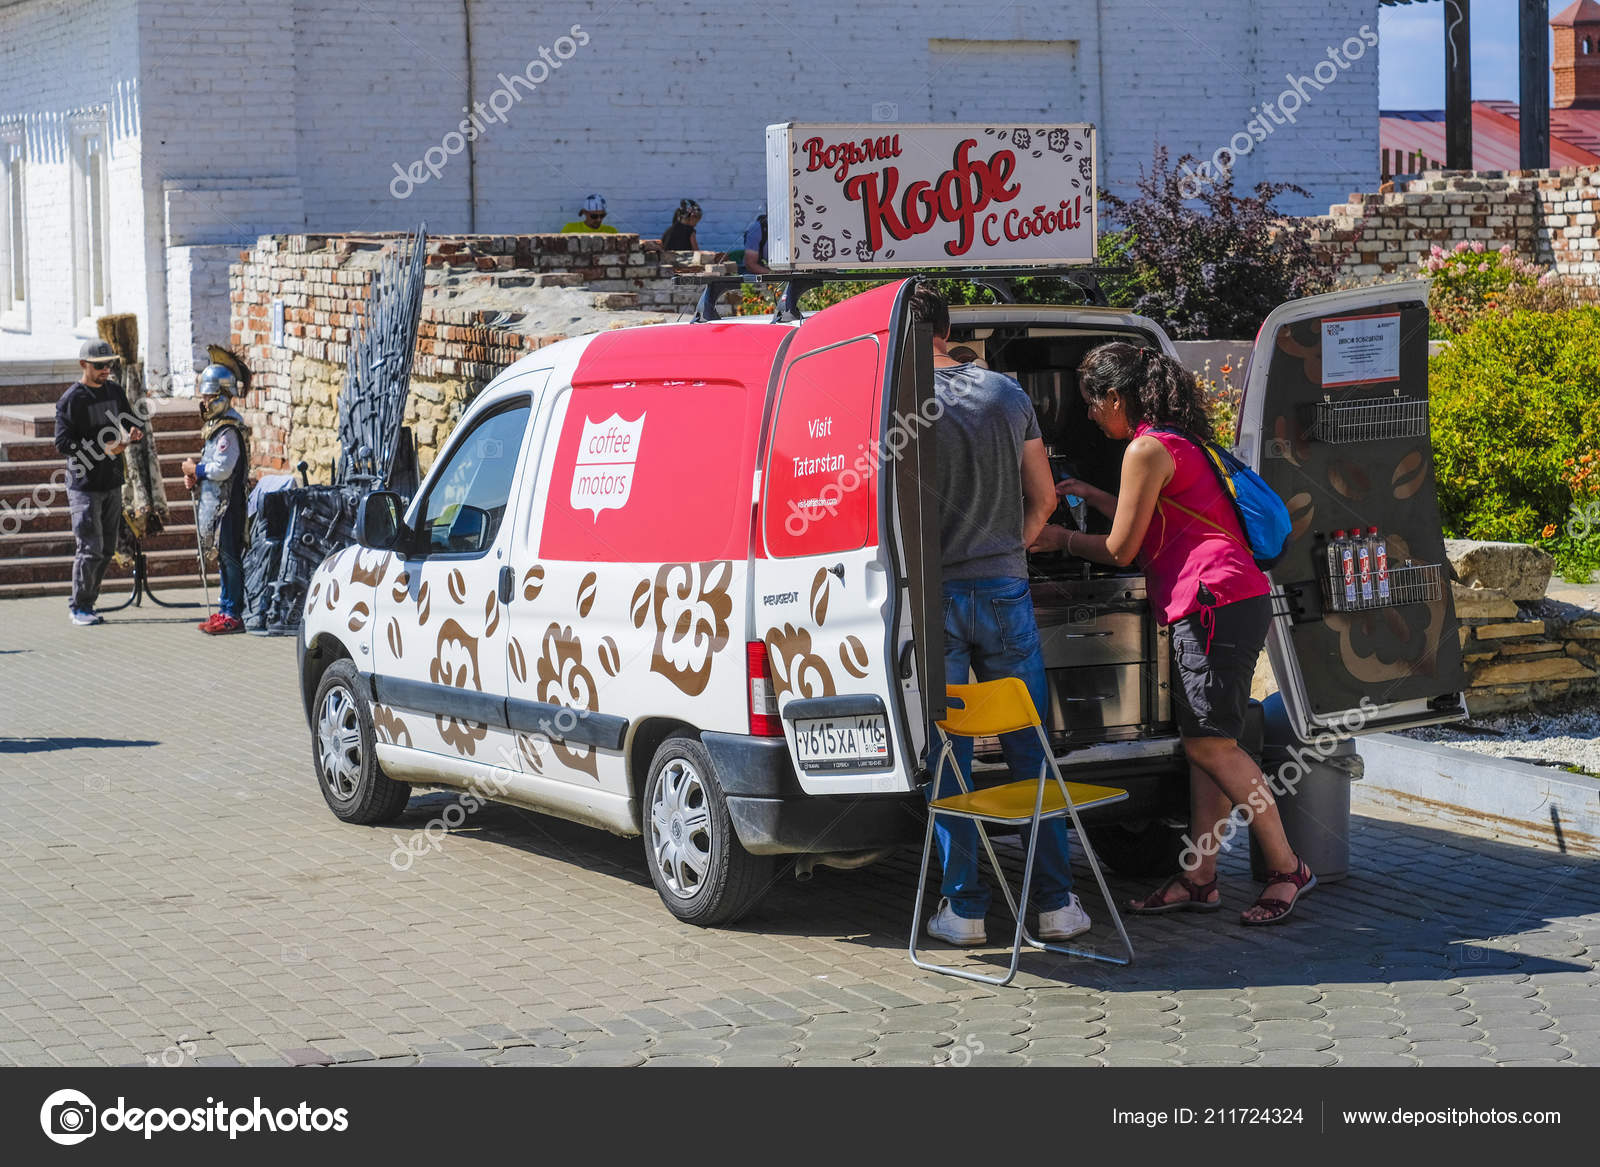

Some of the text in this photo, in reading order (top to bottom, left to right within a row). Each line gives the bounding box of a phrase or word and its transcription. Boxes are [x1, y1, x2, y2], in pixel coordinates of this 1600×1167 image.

[802, 133, 903, 183] Возьми
[843, 138, 1021, 257] Кофе
[1003, 195, 1081, 242] Собой!
[588, 426, 631, 455] coffee
[808, 416, 832, 439] Visit
[793, 452, 845, 478] Tatarstan
[577, 472, 627, 496] motors
[858, 718, 882, 744] 116
